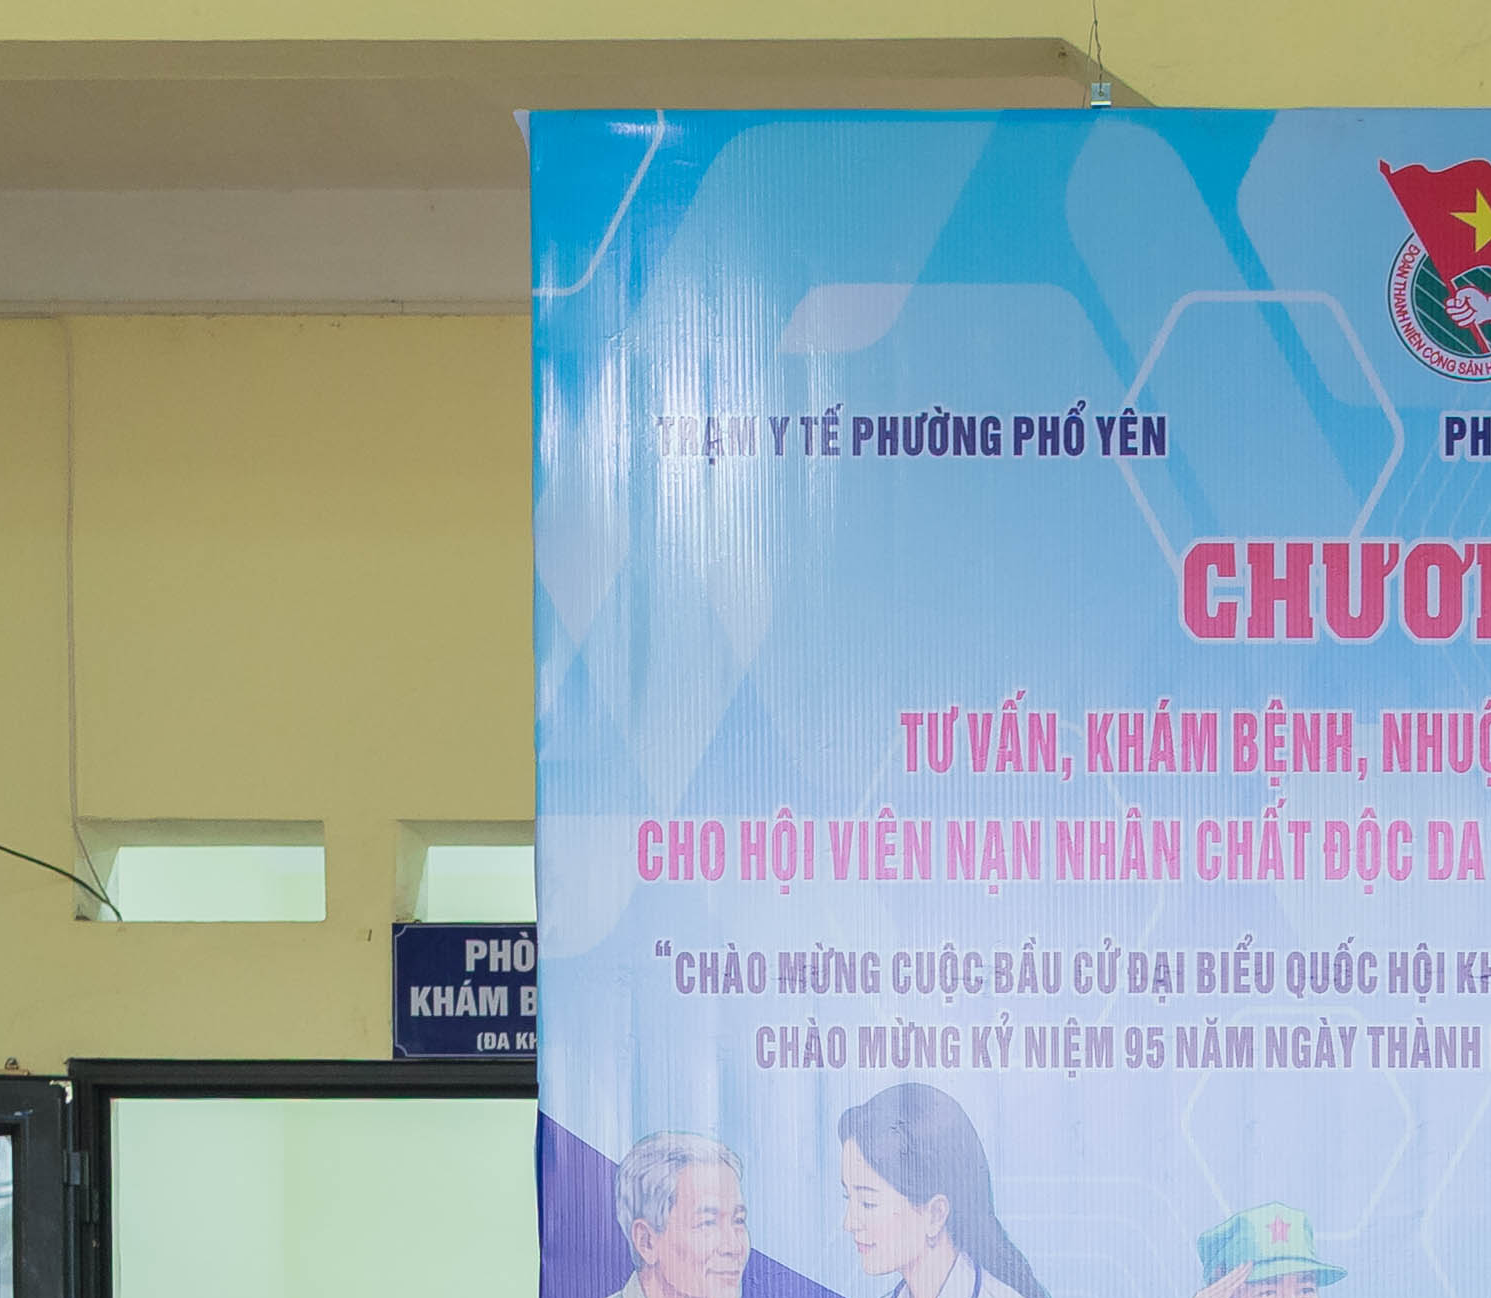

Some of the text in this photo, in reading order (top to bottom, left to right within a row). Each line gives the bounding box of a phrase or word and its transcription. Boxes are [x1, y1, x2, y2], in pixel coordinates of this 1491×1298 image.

[1394, 279, 1408, 327] THANH
[1402, 324, 1426, 354] NIÊN
[769, 416, 790, 457] Y
[800, 403, 844, 457] TẾ
[852, 405, 1002, 457] PHƯỜNG
[1013, 400, 1087, 457] PHỔ
[1097, 408, 1166, 457] YÊN
[901, 706, 959, 772] TƯ
[968, 690, 1072, 781] VẤN,
[1087, 699, 1218, 772] KHÁM
[1234, 700, 1368, 787] BỆNH,
[638, 819, 726, 881] CHO
[741, 807, 814, 894] HỘI
[829, 808, 932, 881] VIÊN
[947, 821, 1041, 894] NẠN
[1056, 807, 1181, 881] NHÂN
[1197, 798, 1310, 881] CHẤT
[1323, 808, 1412, 894] ĐỘC
[1428, 821, 1486, 881] DA
[410, 979, 508, 1016] KHÁM
[655, 940, 767, 994] “CHÀO
[779, 941, 880, 994] MỪNG
[892, 942, 983, 1004] CUỘC
[995, 937, 1060, 994] BẦU
[1073, 937, 1121, 994] CỬ
[1127, 951, 1189, 1004] ĐẠI
[1197, 934, 1274, 994] BIỂU
[1286, 936, 1377, 1000] QUỐC
[1388, 942, 1445, 1004] HỘI
[477, 1032, 510, 1051] (ĐA
[756, 1017, 846, 1069] CHÀO
[858, 1017, 960, 1069] MỪNG
[972, 1011, 1014, 1069] KỶ
[1025, 1017, 1113, 1078] NIỆM
[1125, 1027, 1165, 1069] 95
[1177, 1017, 1254, 1069] NĂM
[1265, 1017, 1358, 1069] NGÀY
[1367, 1017, 1481, 1069] THÀNH
